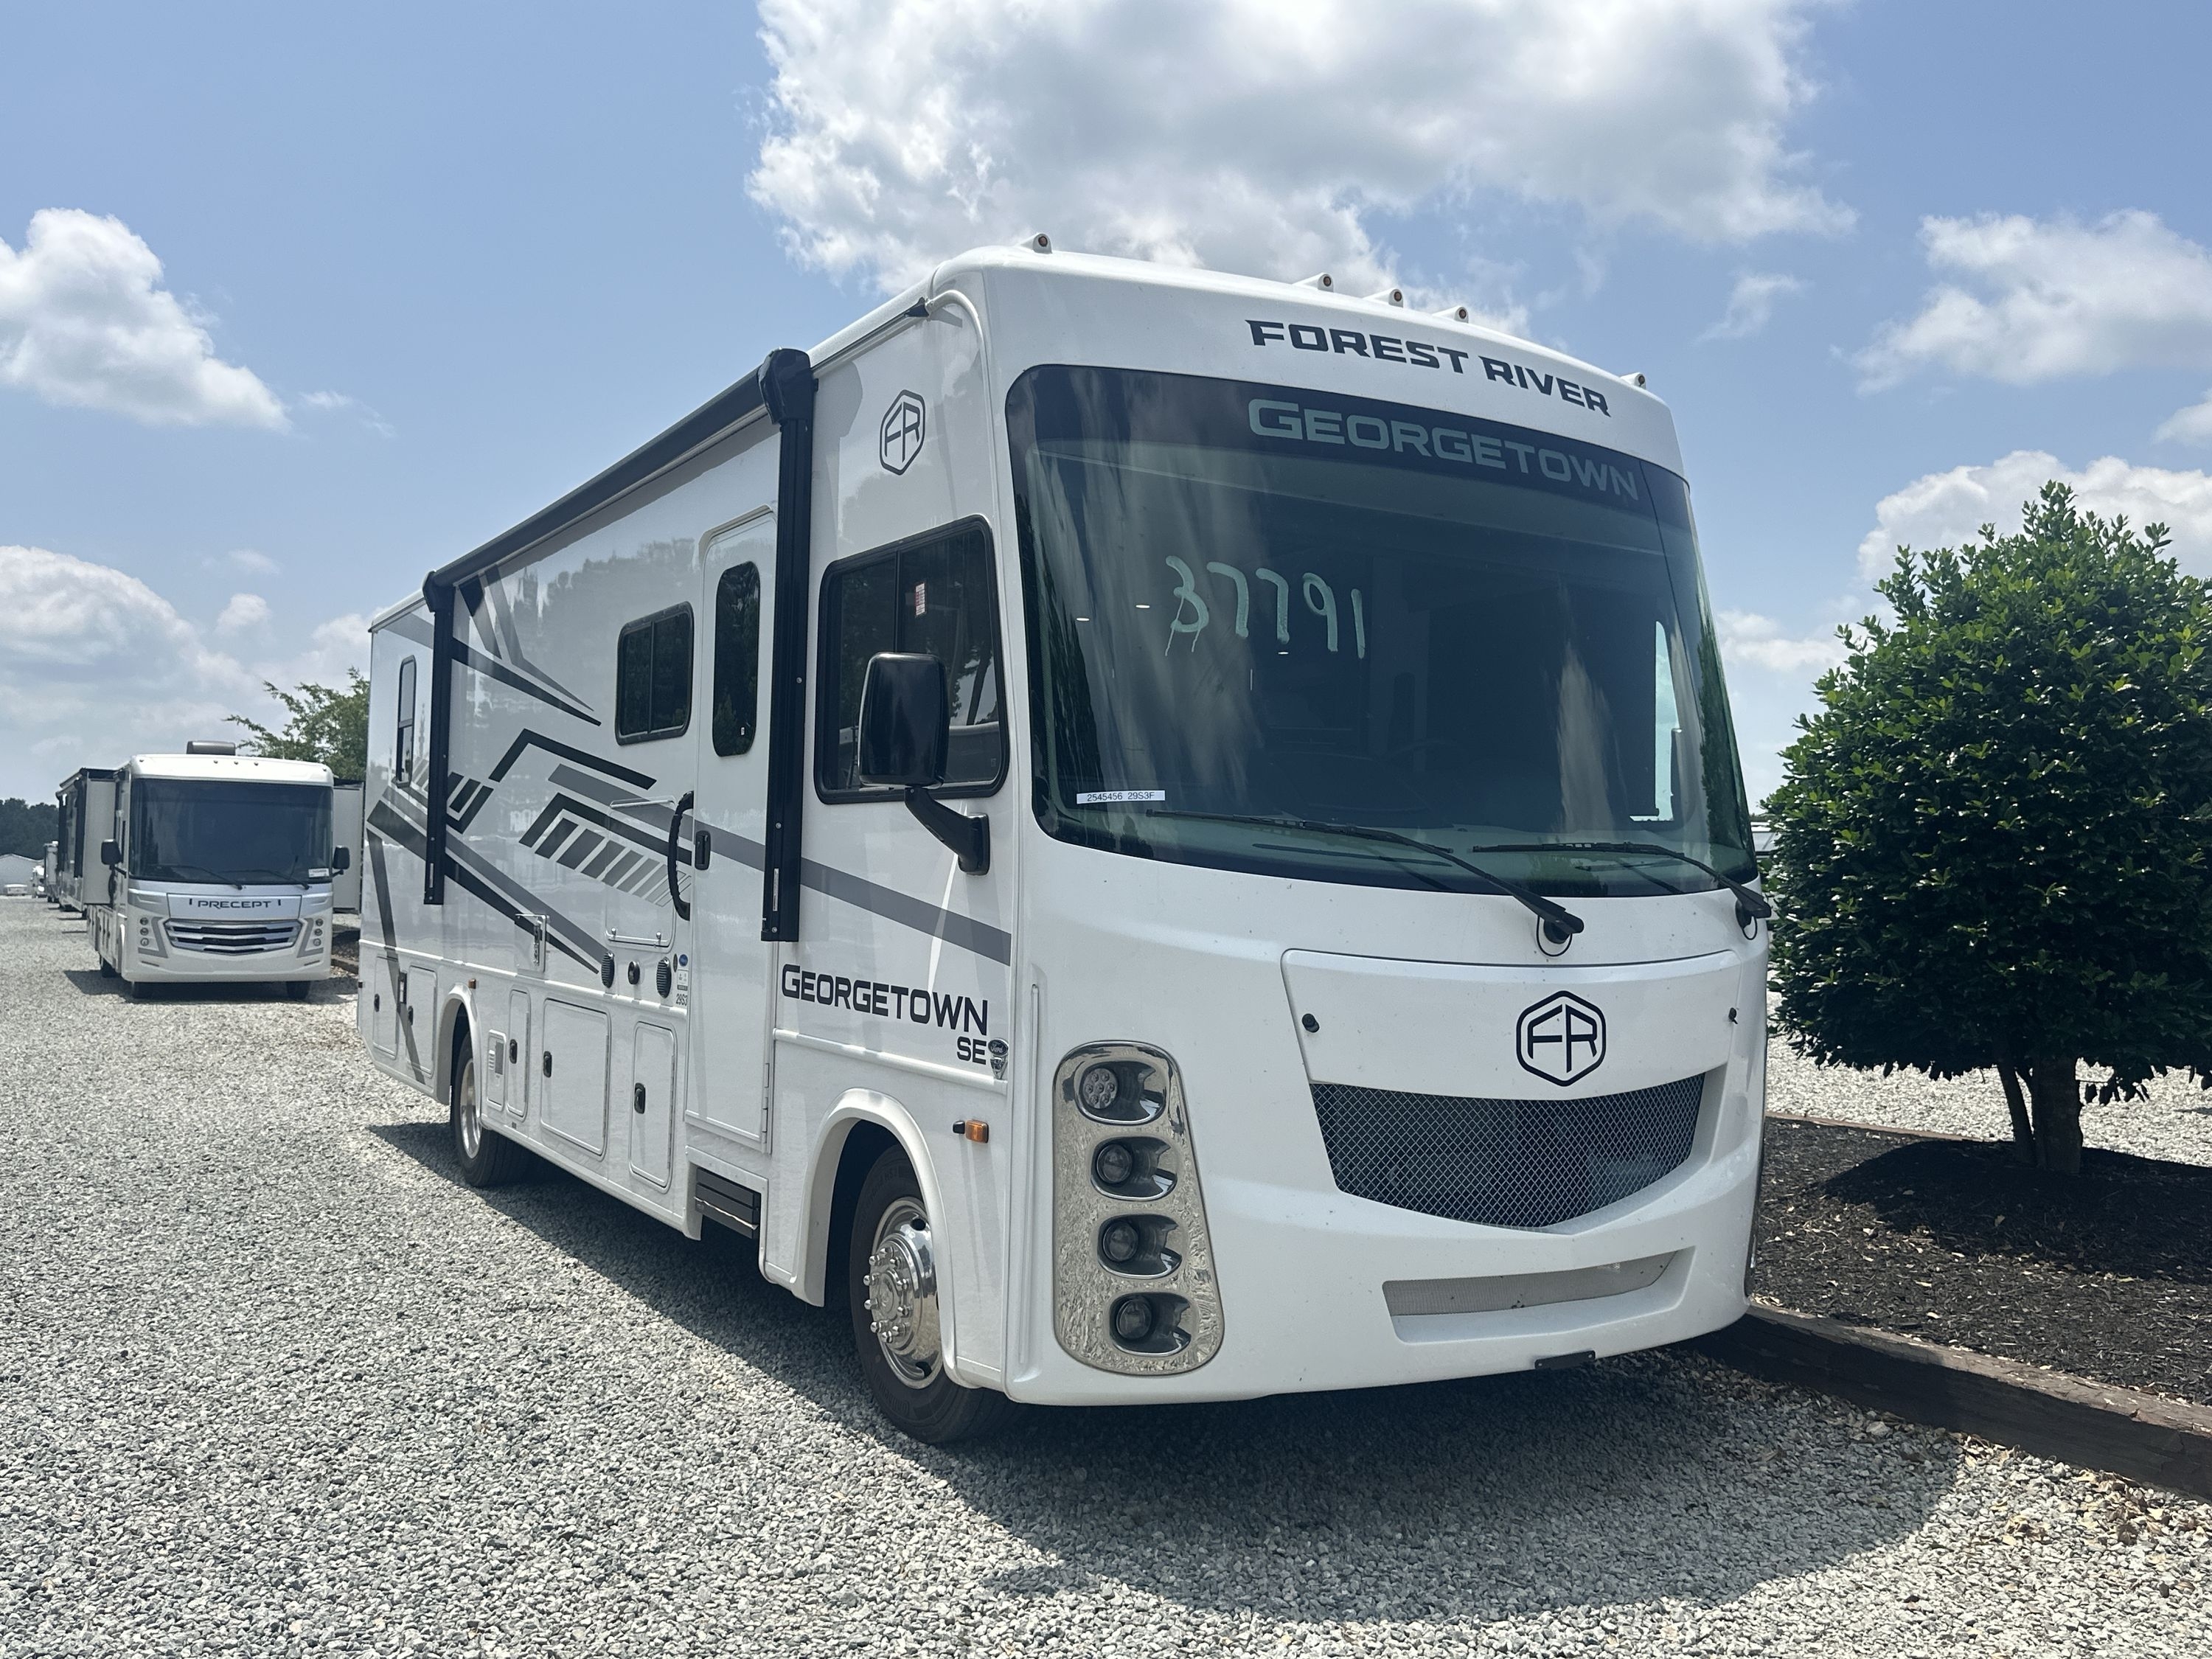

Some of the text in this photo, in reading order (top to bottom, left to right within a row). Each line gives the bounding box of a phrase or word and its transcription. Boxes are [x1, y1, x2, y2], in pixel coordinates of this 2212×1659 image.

[1245, 320, 1612, 417] FOREST RIVER
[1248, 398, 1640, 501] GEORGETOWN
[1165, 555, 1366, 659] 37791
[1087, 791, 1155, 801] 2545456 29S3F
[198, 900, 271, 909] PRECEPT
[782, 964, 987, 1036] GEORGETOWN
[956, 1036, 987, 1065] SE
